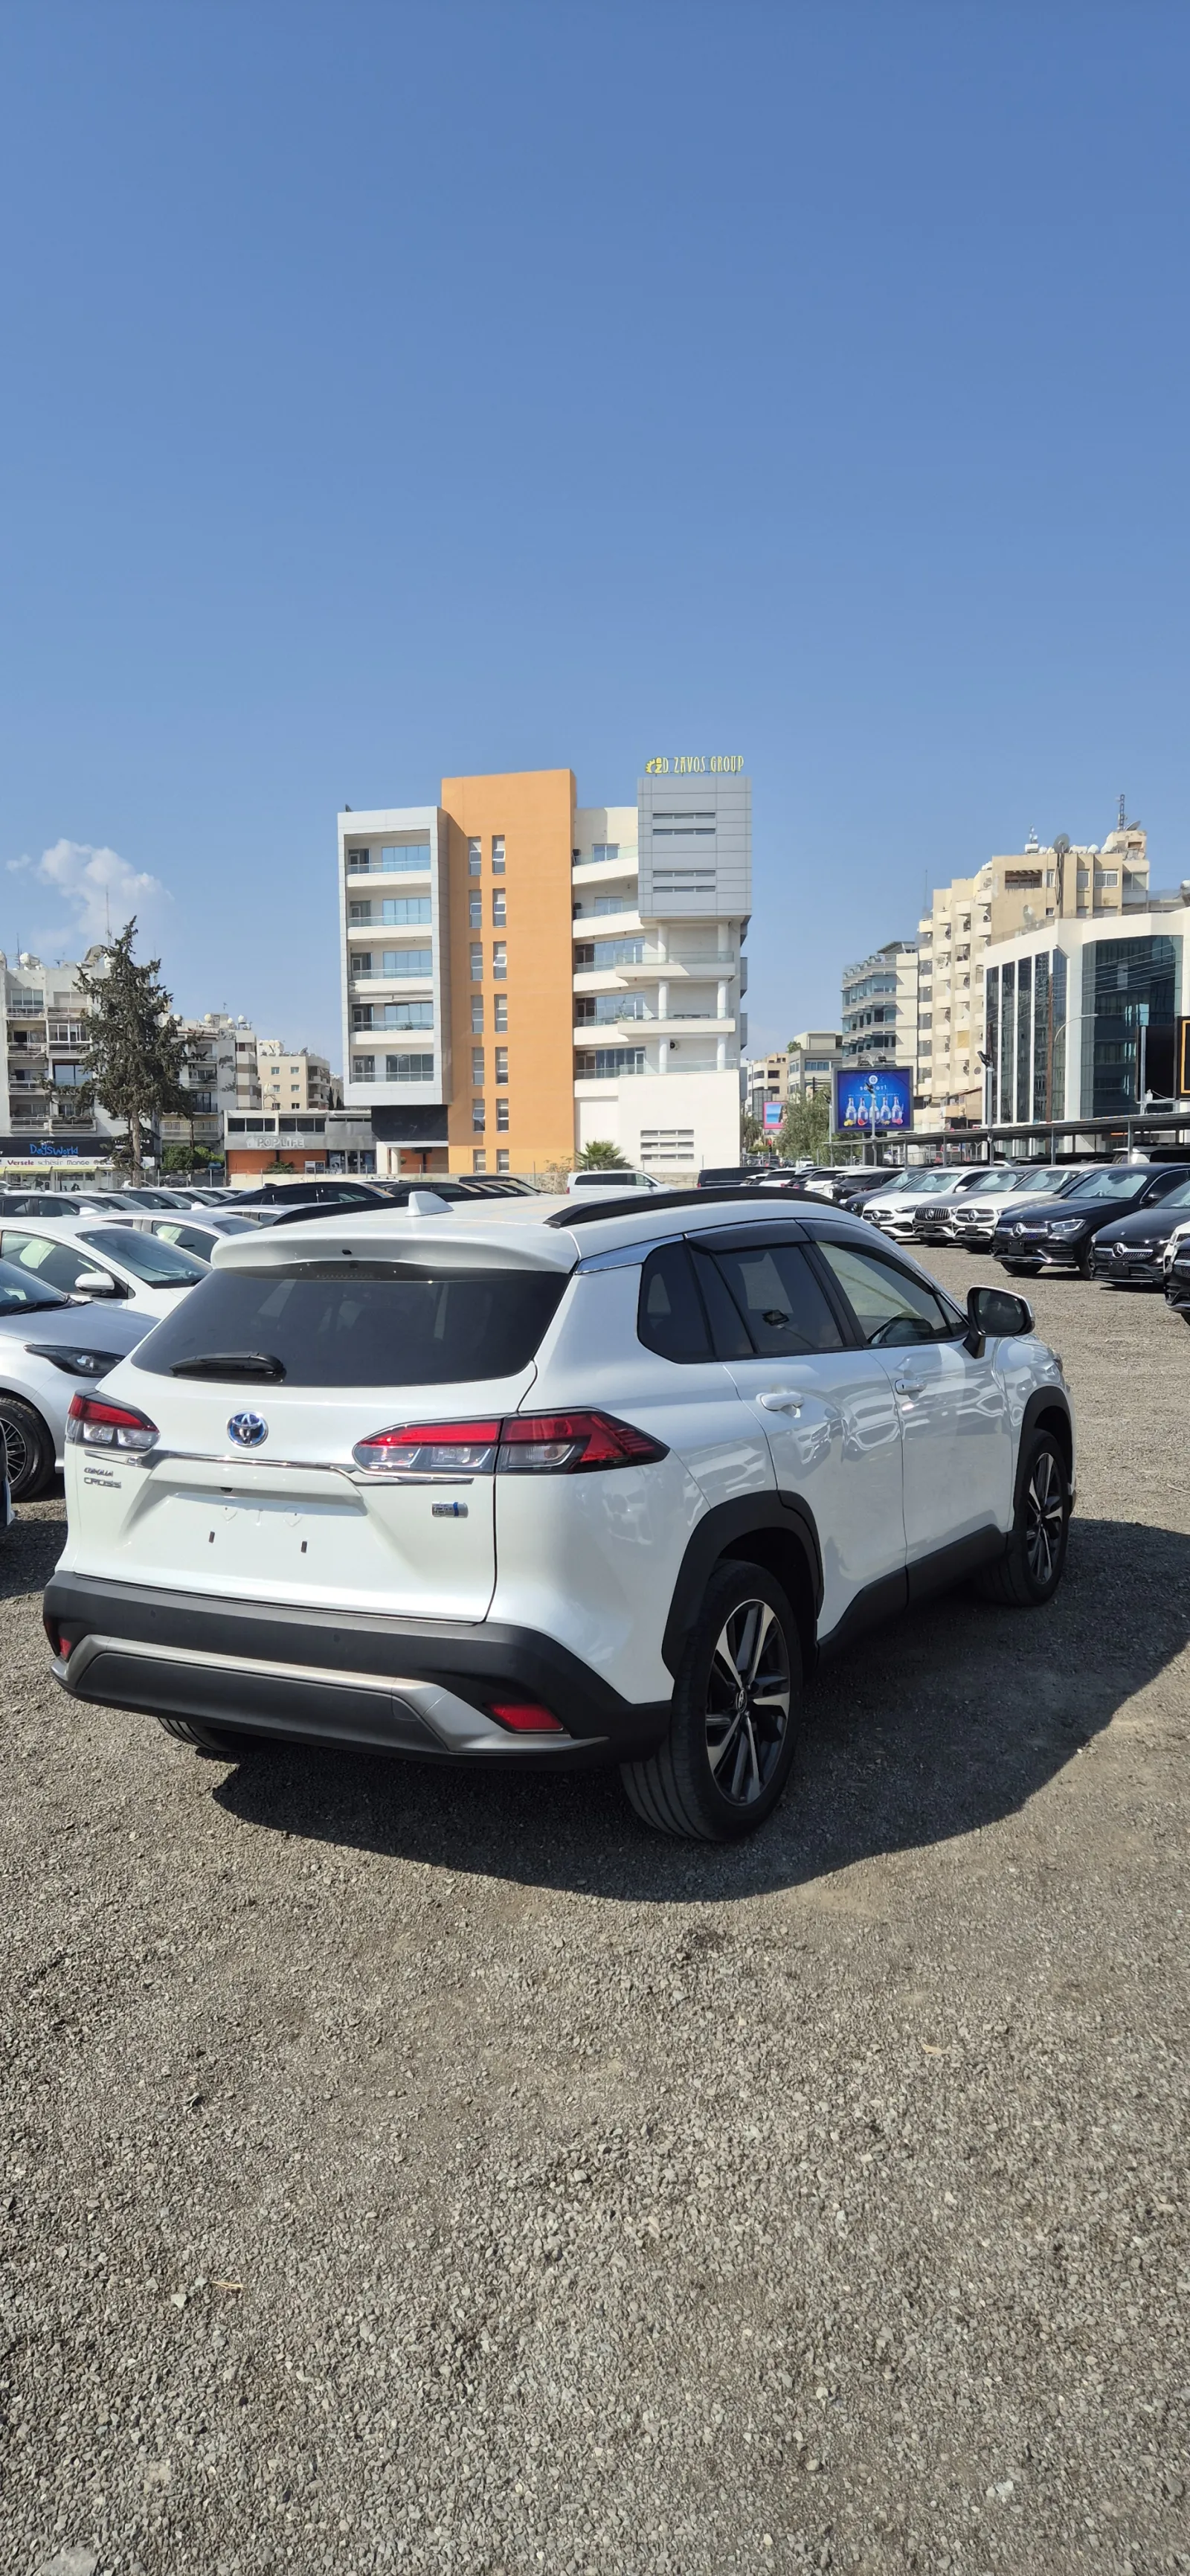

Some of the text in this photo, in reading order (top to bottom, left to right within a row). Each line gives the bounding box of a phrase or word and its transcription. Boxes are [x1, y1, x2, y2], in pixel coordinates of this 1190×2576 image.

[674, 757, 706, 773] ZAVOS
[710, 756, 744, 772] GROUP
[257, 1137, 280, 1148] POP
[83, 1477, 122, 1488] CROSS
